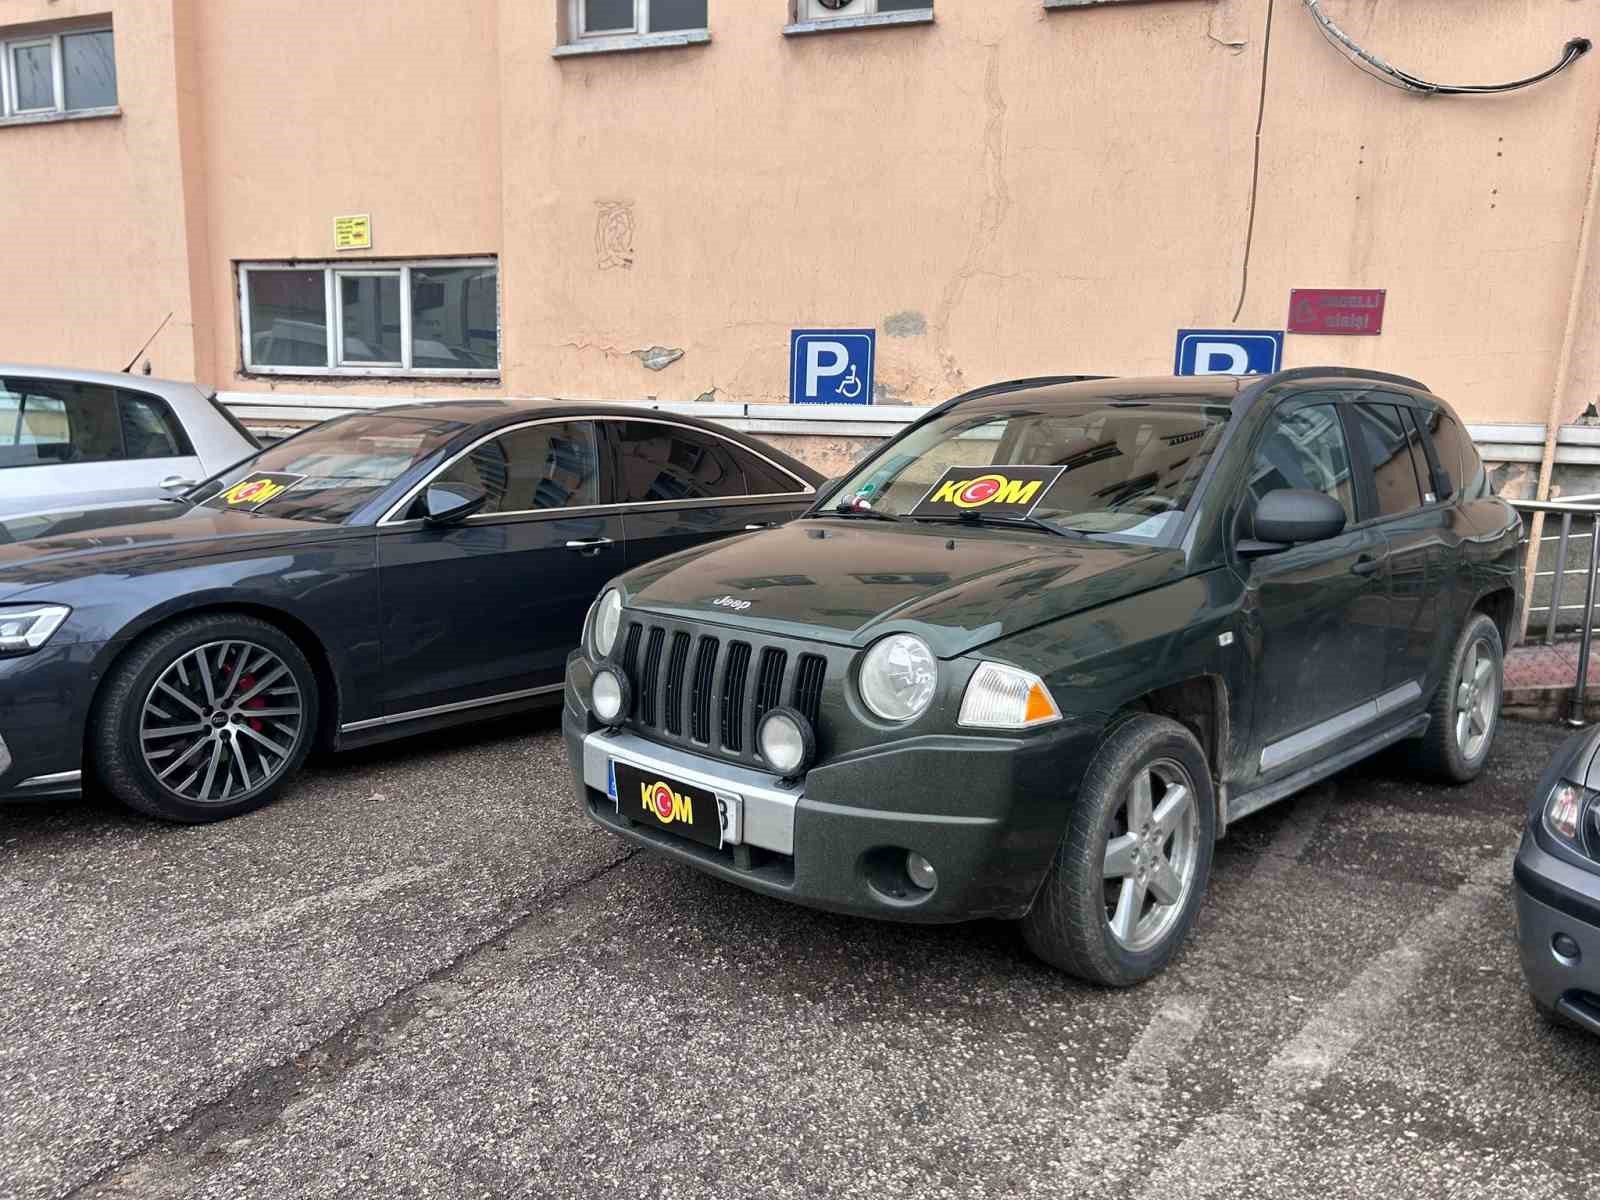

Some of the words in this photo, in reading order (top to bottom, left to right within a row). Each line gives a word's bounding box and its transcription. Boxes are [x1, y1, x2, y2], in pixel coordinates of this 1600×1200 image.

[806, 341, 849, 397] P
[930, 474, 1044, 508] KOM
[713, 595, 752, 610] Jeep
[641, 781, 693, 825] KOM
